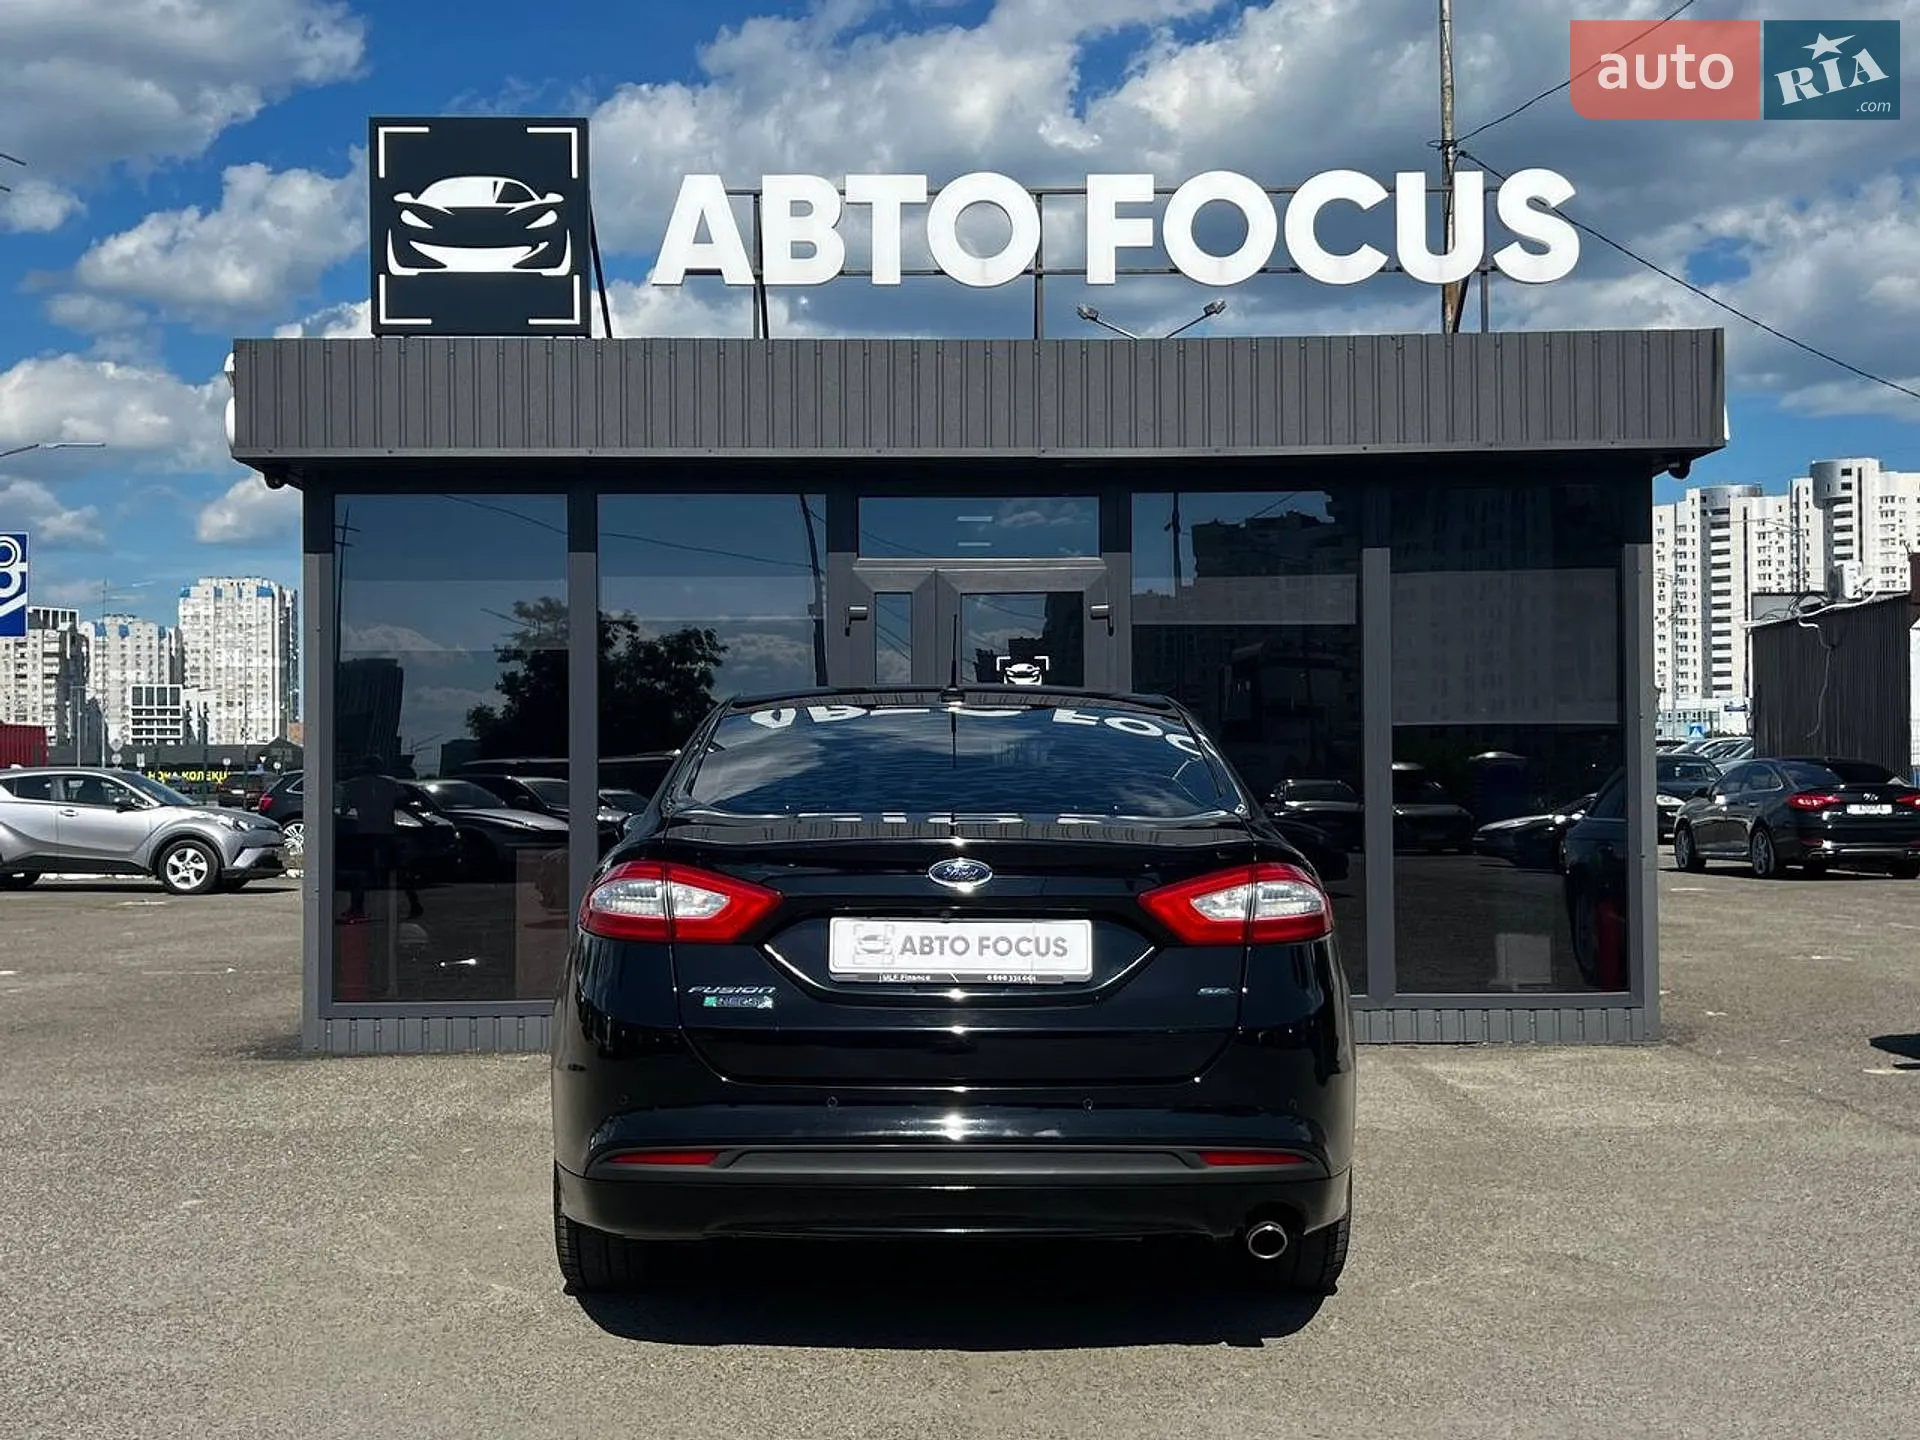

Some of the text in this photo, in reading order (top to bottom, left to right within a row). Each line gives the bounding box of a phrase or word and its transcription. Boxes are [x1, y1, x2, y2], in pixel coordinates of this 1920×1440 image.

[651, 168, 1580, 287] АВТО FOCUS
[900, 936, 1068, 957] АВТО FOCUS
[687, 985, 776, 994] FUSION
